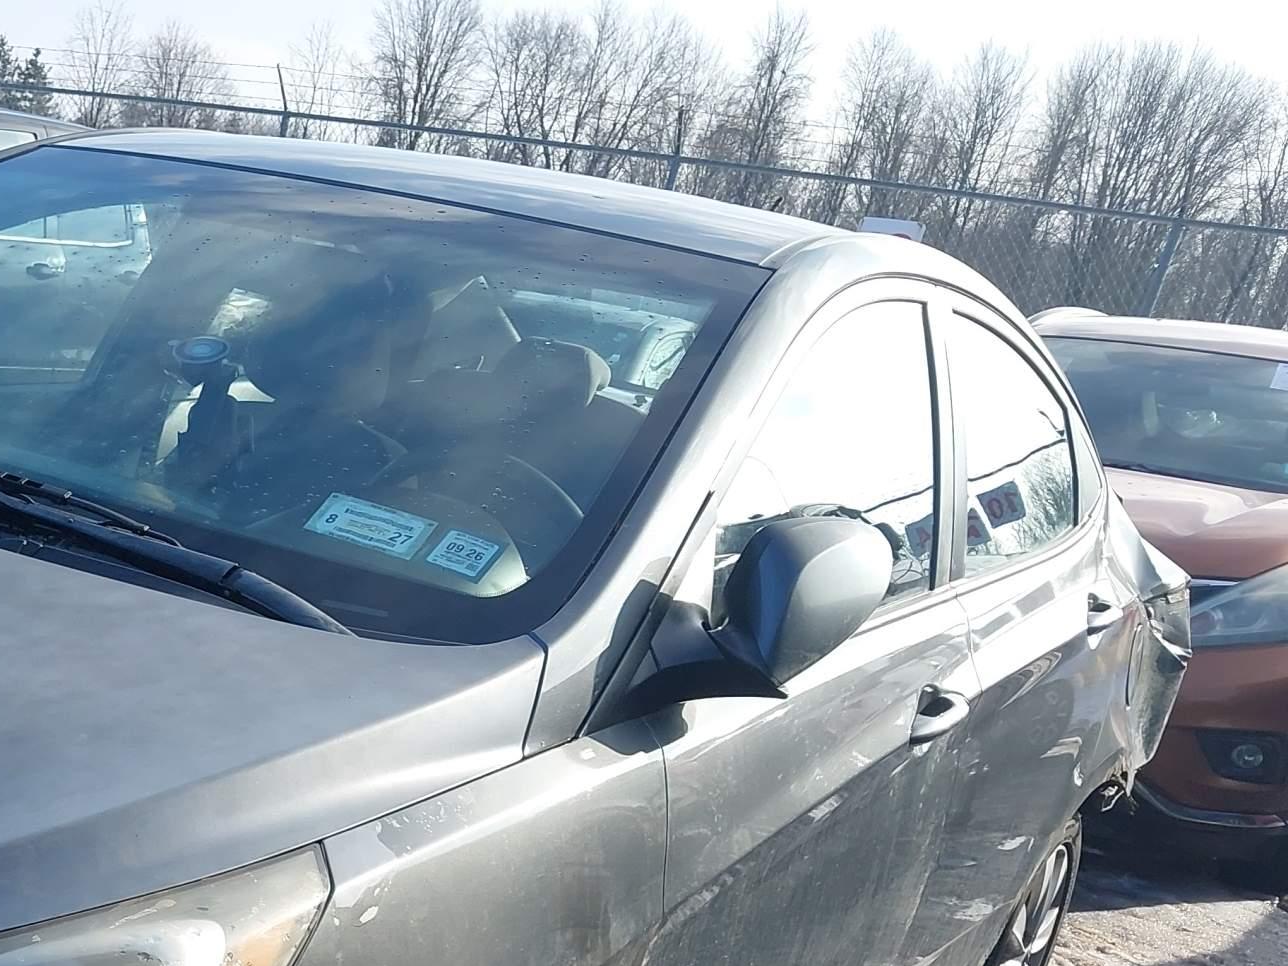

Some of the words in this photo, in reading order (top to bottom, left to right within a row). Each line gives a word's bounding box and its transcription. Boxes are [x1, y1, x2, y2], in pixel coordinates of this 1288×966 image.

[325, 513, 339, 524] 8
[388, 531, 414, 545] 27
[445, 542, 465, 553] 09
[465, 548, 486, 561] 26
